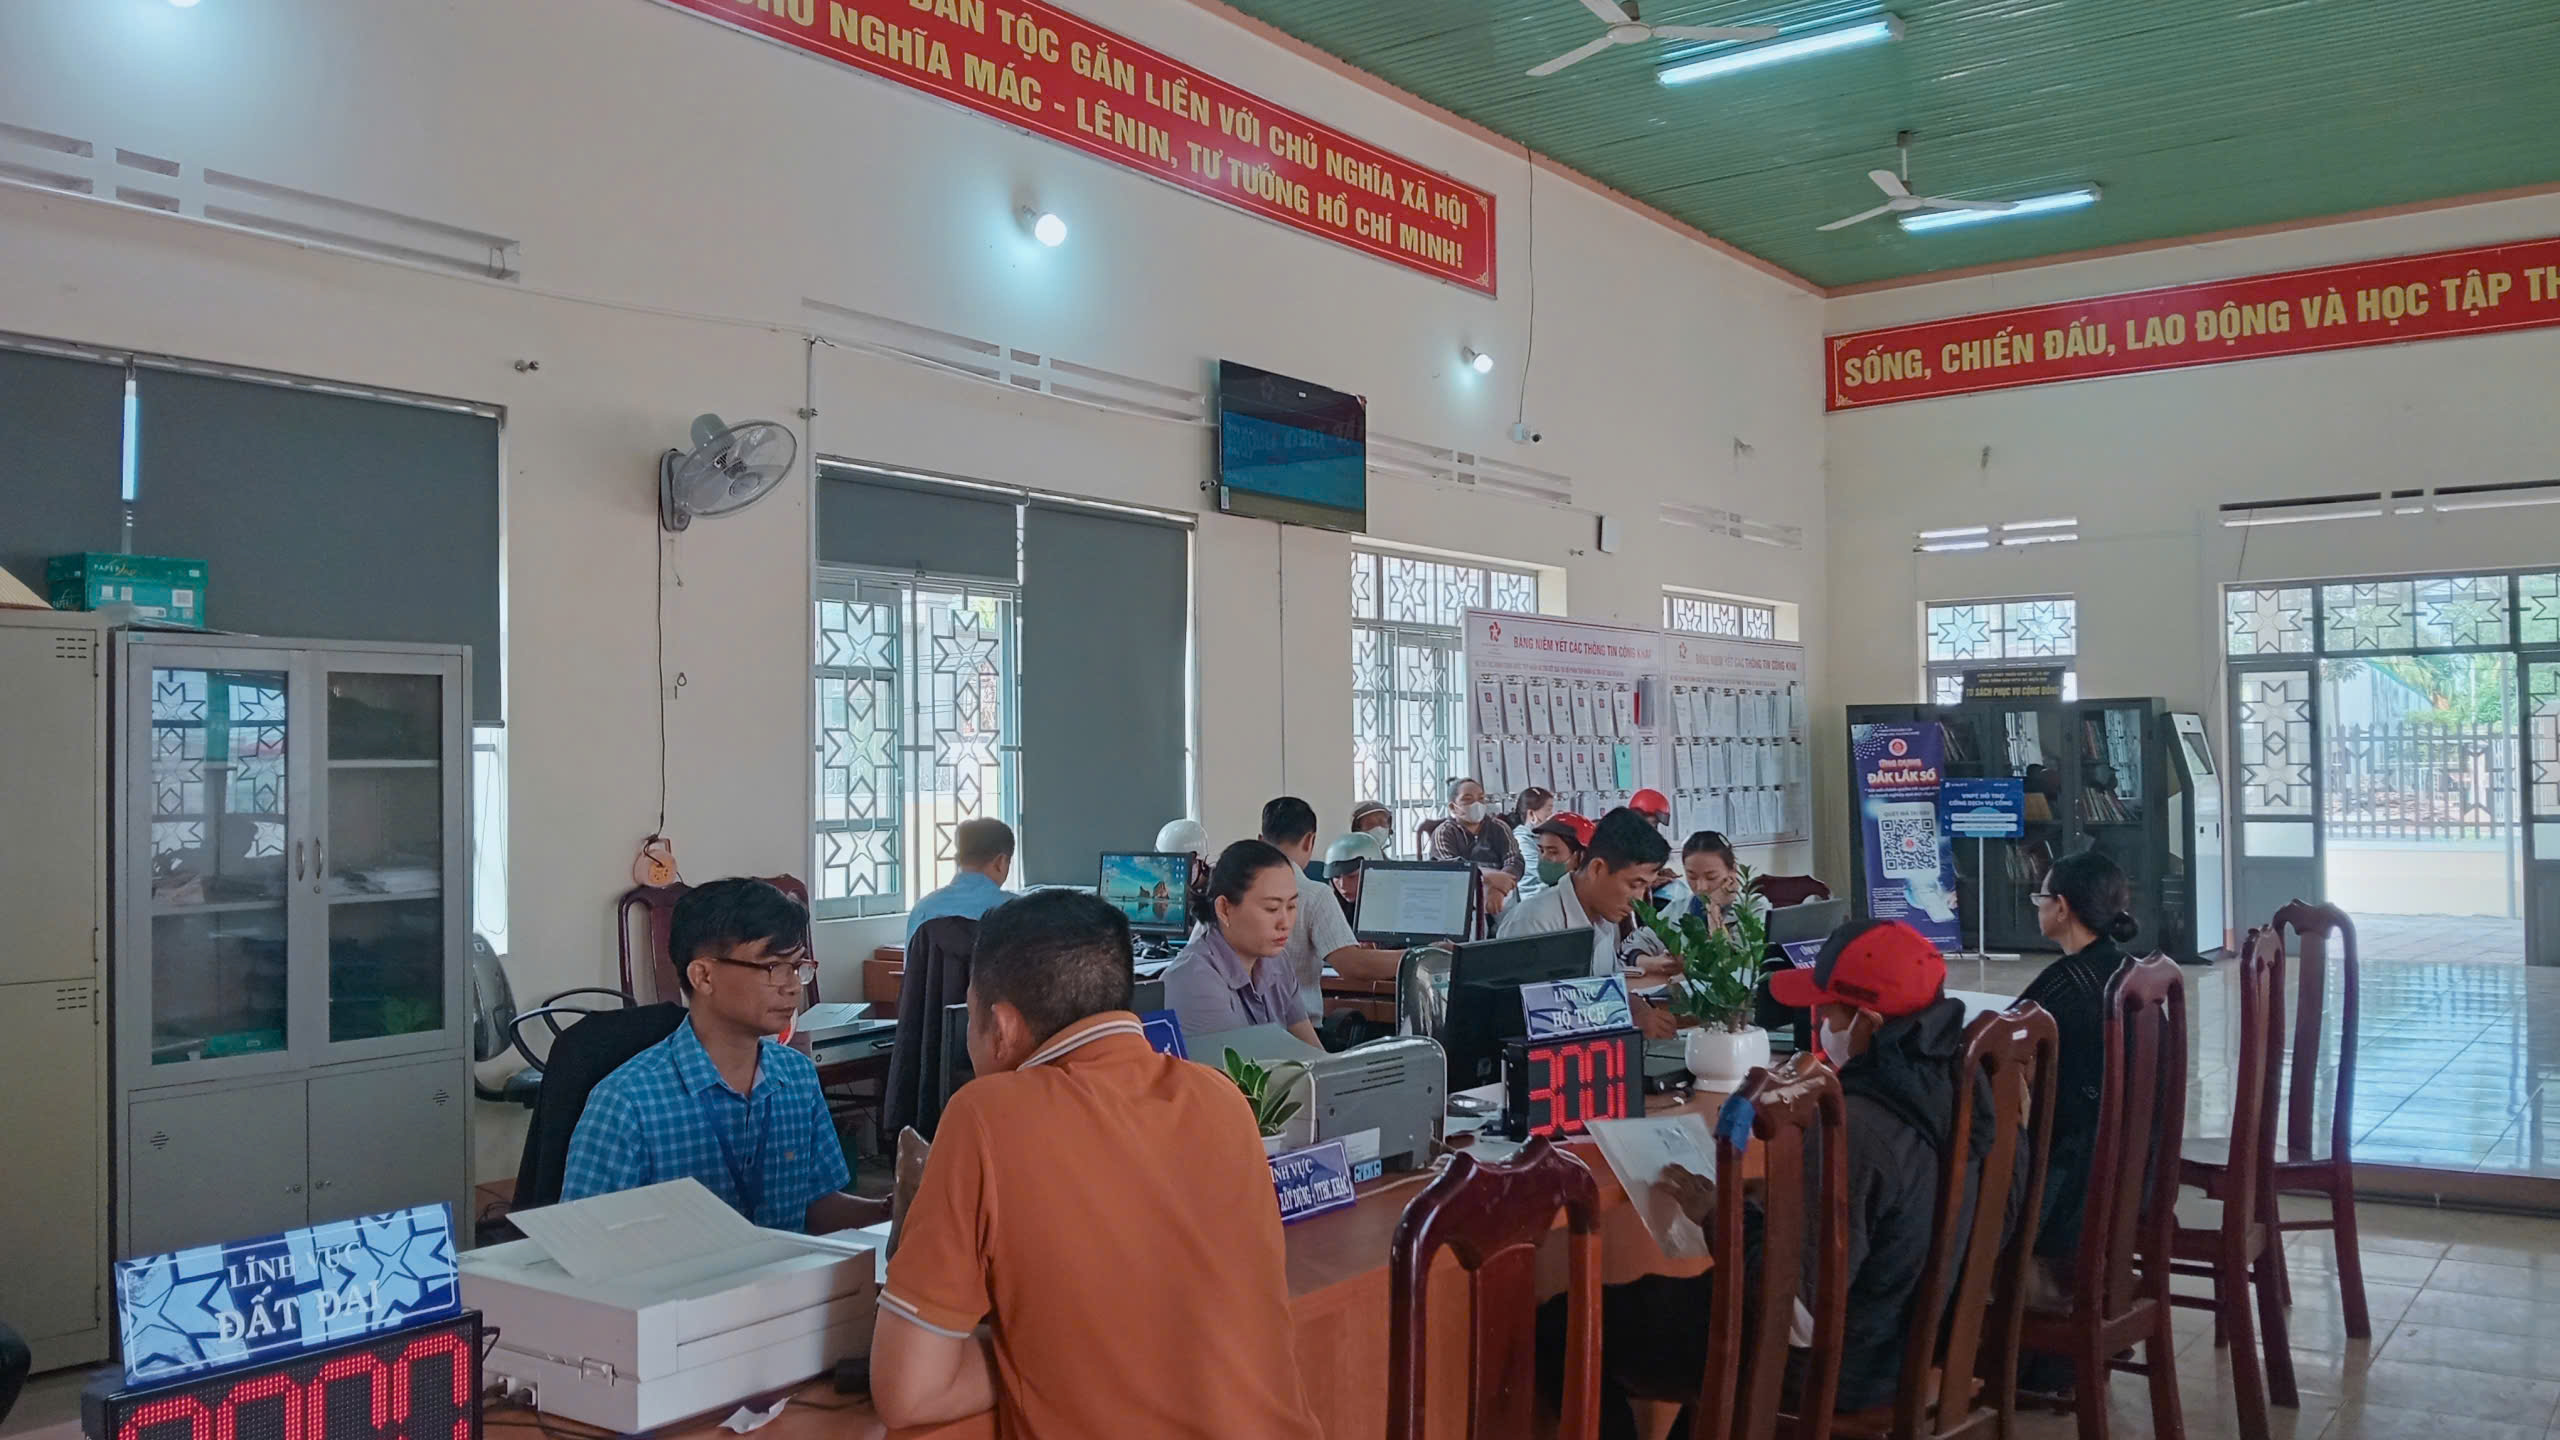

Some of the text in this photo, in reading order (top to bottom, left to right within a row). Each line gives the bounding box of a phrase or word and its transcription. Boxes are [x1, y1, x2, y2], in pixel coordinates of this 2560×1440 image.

[830, 1, 952, 80] NGHĨA
[964, 52, 1042, 112] MÁC
[1077, 97, 1178, 168] LÊNIN,
[1187, 141, 1223, 180] TƯ
[1228, 157, 1309, 216] TƯỞNG
[1318, 192, 1348, 228] HỒ
[1355, 207, 1392, 244] CHÍ
[1400, 223, 1463, 269] MINH!
[997, 8, 1059, 63] TỘC
[1072, 42, 1135, 95] GẮN
[1145, 72, 1210, 126] LIỀN
[1218, 102, 1260, 147] VỚI
[1269, 126, 1318, 169] CHỦ
[1326, 149, 1396, 201] NGHĨA
[1401, 179, 1429, 214] XÃ
[1435, 191, 1468, 230] HỘI
[1844, 345, 1932, 387] SỐNG,
[1941, 326, 2034, 373] CHIẾN
[2043, 316, 2116, 361] ĐẤU,
[2126, 313, 2186, 351] LAO
[2195, 301, 2290, 345] ĐỘNG
[2300, 287, 2347, 330] VÀ
[2357, 283, 2429, 326] HỌC
[2441, 269, 2512, 316] TẬP
[1552, 1005, 1608, 1029] HỘ TỊCH
[1554, 986, 1576, 1002] LĨNH
[1528, 1038, 1627, 1136] 3001
[1290, 1157, 1314, 1179] VỰC
[227, 1253, 296, 1289] LĨNH
[217, 1279, 381, 1344] ĐẤT ĐAI
